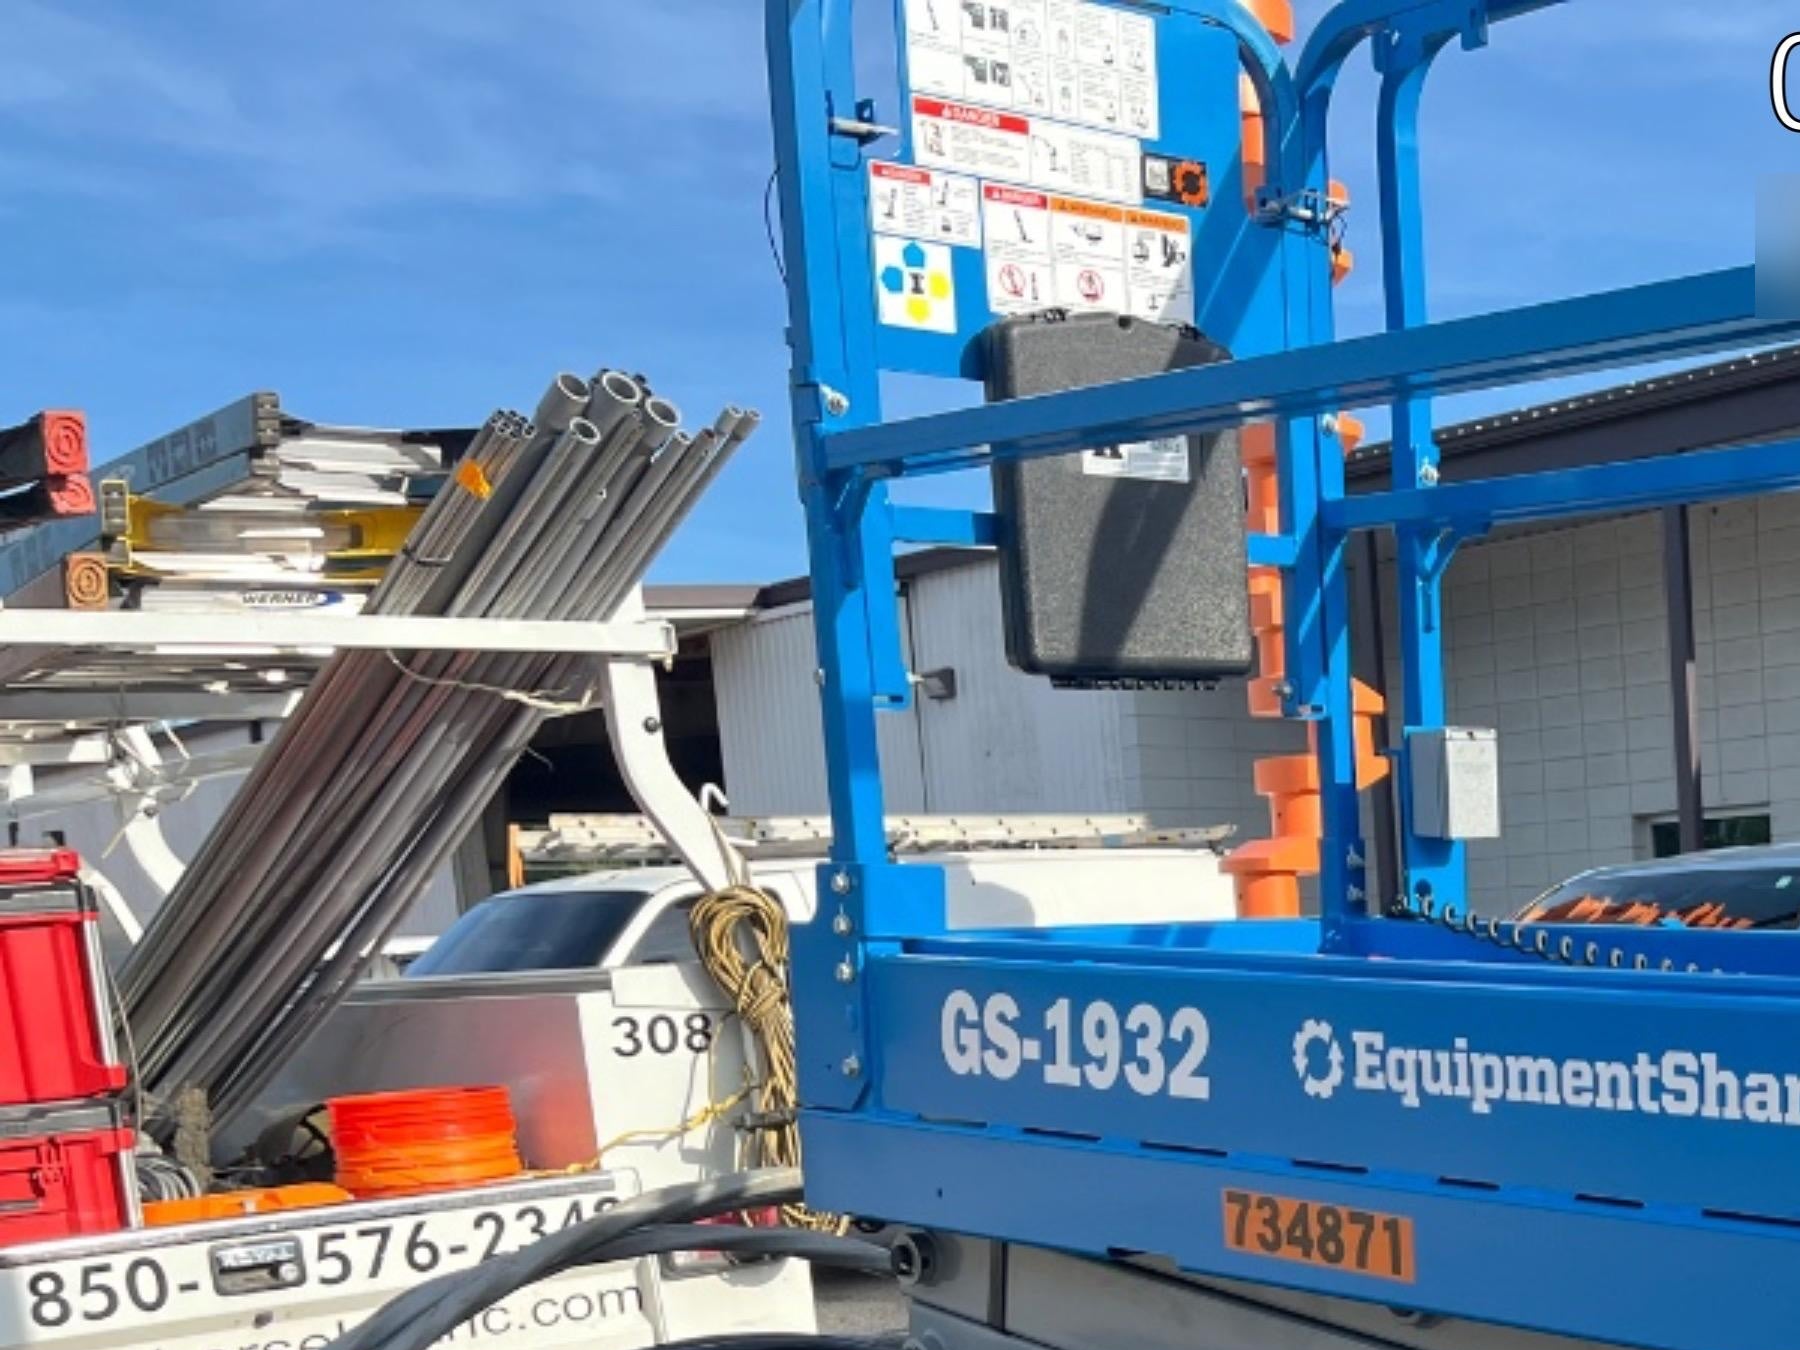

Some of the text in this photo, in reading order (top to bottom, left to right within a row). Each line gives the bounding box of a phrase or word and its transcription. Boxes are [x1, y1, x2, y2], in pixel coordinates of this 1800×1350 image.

[611, 1012, 713, 1058] 308
[941, 989, 1211, 1100] GS-1932
[1225, 1191, 1402, 1275] 734871
[28, 1256, 199, 1328] 850-
